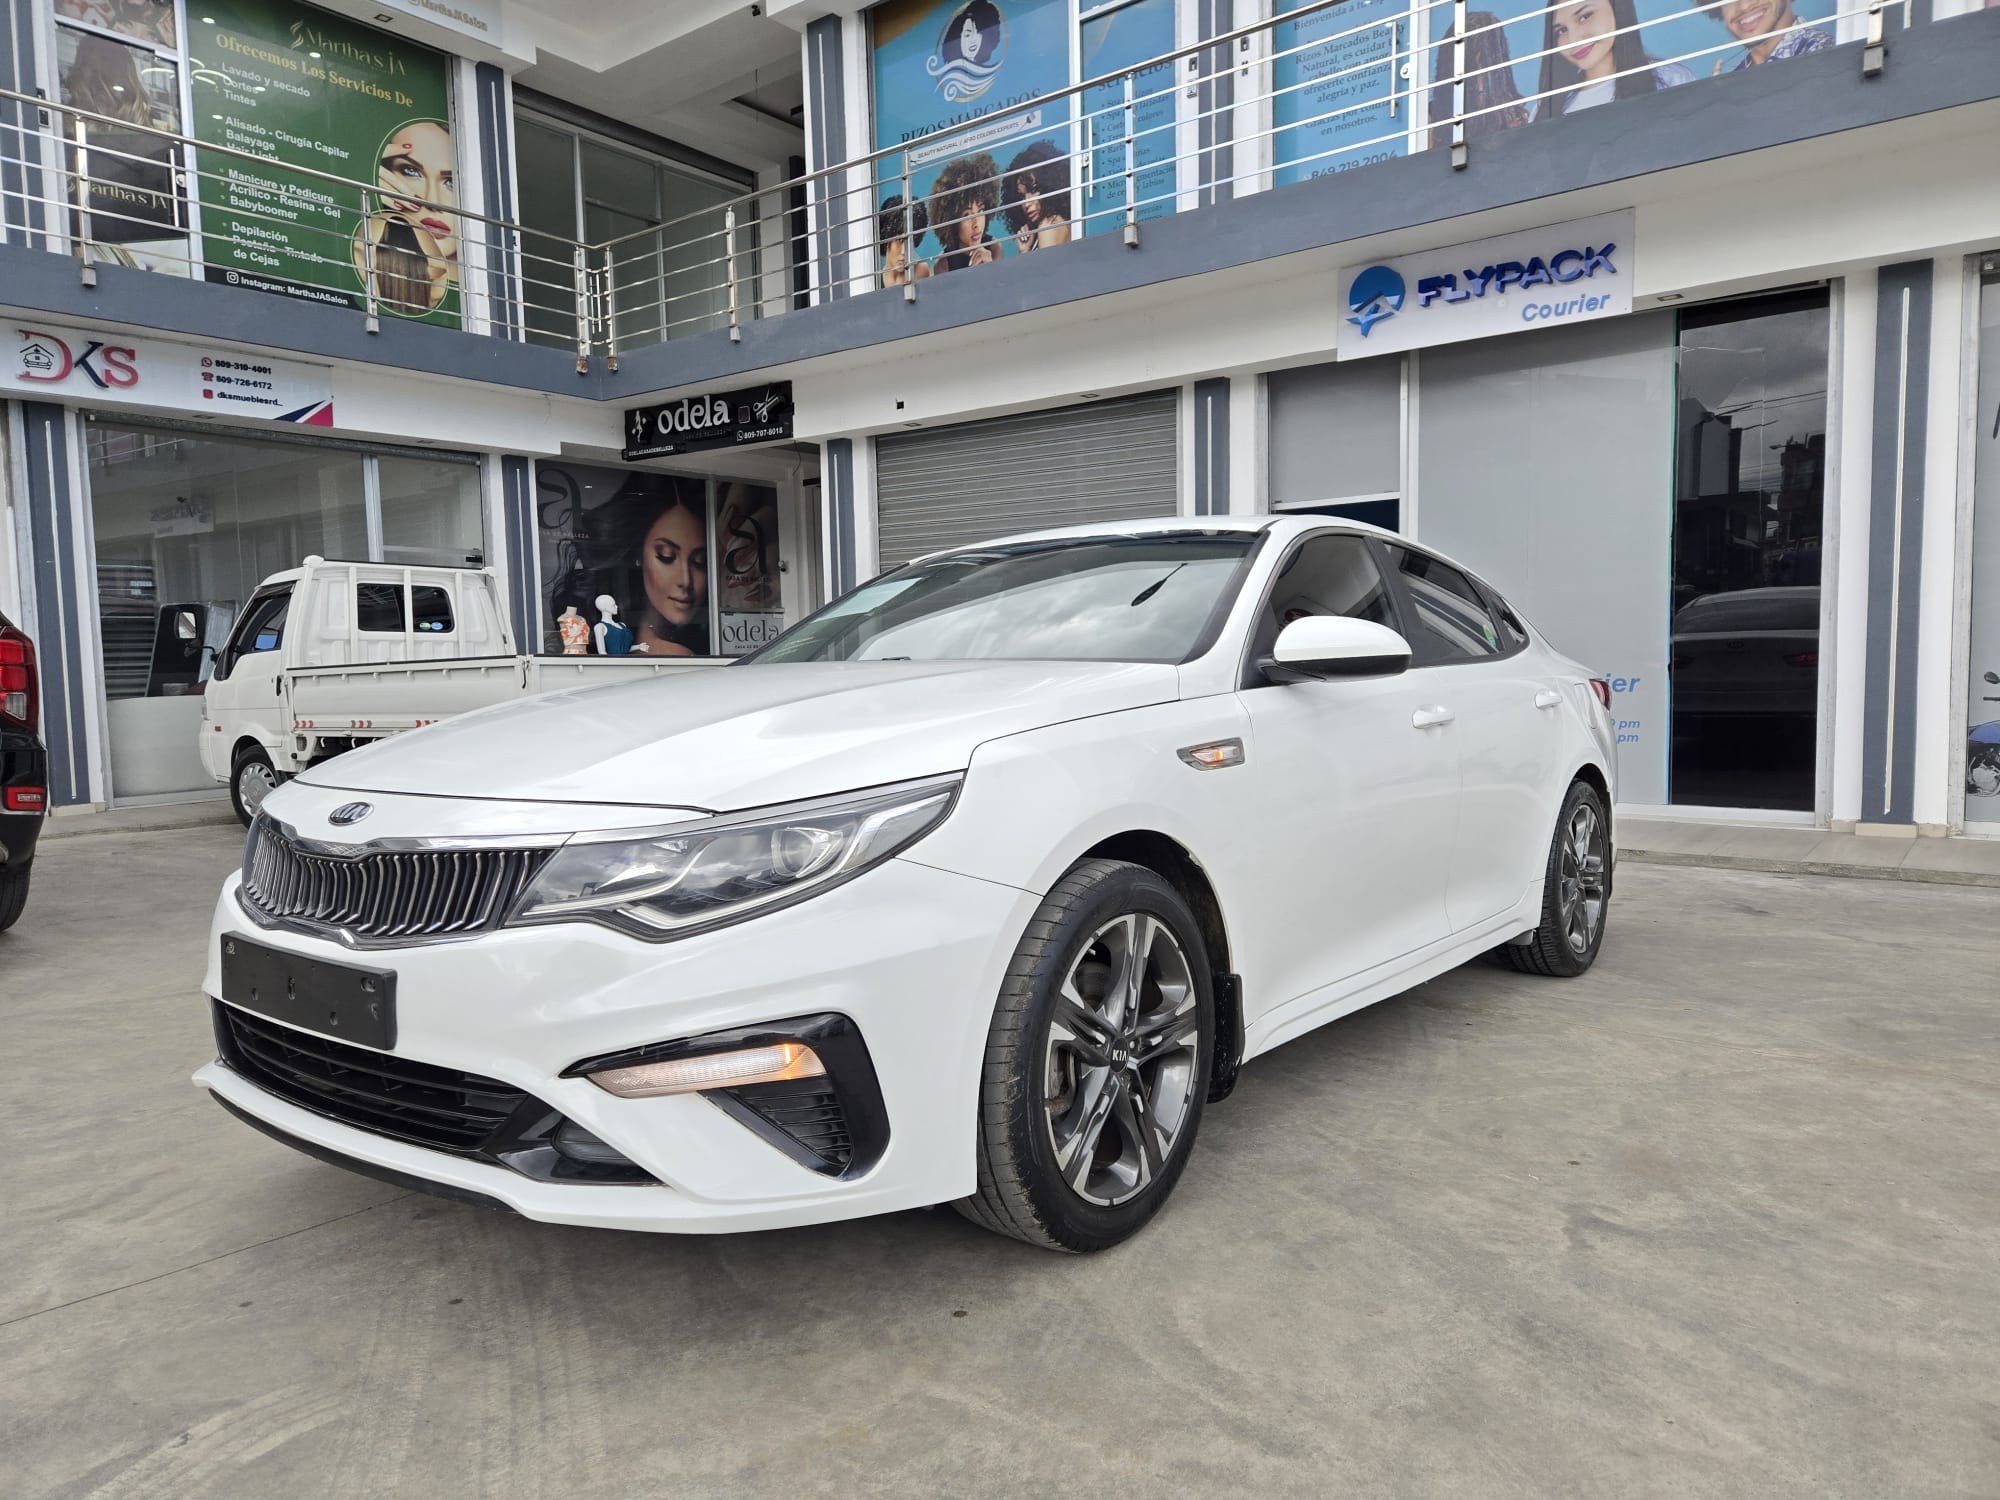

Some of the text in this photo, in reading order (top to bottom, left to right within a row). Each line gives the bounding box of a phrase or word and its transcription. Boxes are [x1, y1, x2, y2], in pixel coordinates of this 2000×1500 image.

[1295, 50, 1322, 65] Rizos
[1323, 34, 1370, 55] Marcados
[1354, 40, 1386, 57] cuidar
[216, 33, 414, 108] Ofrecemos Los Servicios De
[221, 62, 311, 98] Lavado y secado
[223, 89, 257, 107] Tintes
[225, 115, 266, 136] Alisado
[275, 130, 313, 149] Cirugía
[314, 141, 350, 160] Capilar
[226, 129, 276, 151] Balayage
[1321, 127, 1333, 136] en
[1338, 159, 1360, 173] 219
[228, 168, 334, 204] Manicure y Pedicure
[230, 196, 298, 220] Babyboomer
[280, 195, 316, 213] Resina
[323, 205, 341, 219] Gel
[231, 221, 289, 243] Depilación
[233, 248, 280, 267] de Cejas
[1417, 242, 1618, 308] FLYPACK
[241, 276, 348, 306] Instagram: MarthaJASalon
[1521, 292, 1611, 323] Courier
[16, 329, 140, 389] DKS
[215, 375, 273, 390] 809-726-6172
[656, 394, 731, 435] odela
[1618, 720, 1640, 731] pm
[1616, 734, 1639, 745] pm
[1112, 1049, 1127, 1062] KIA
